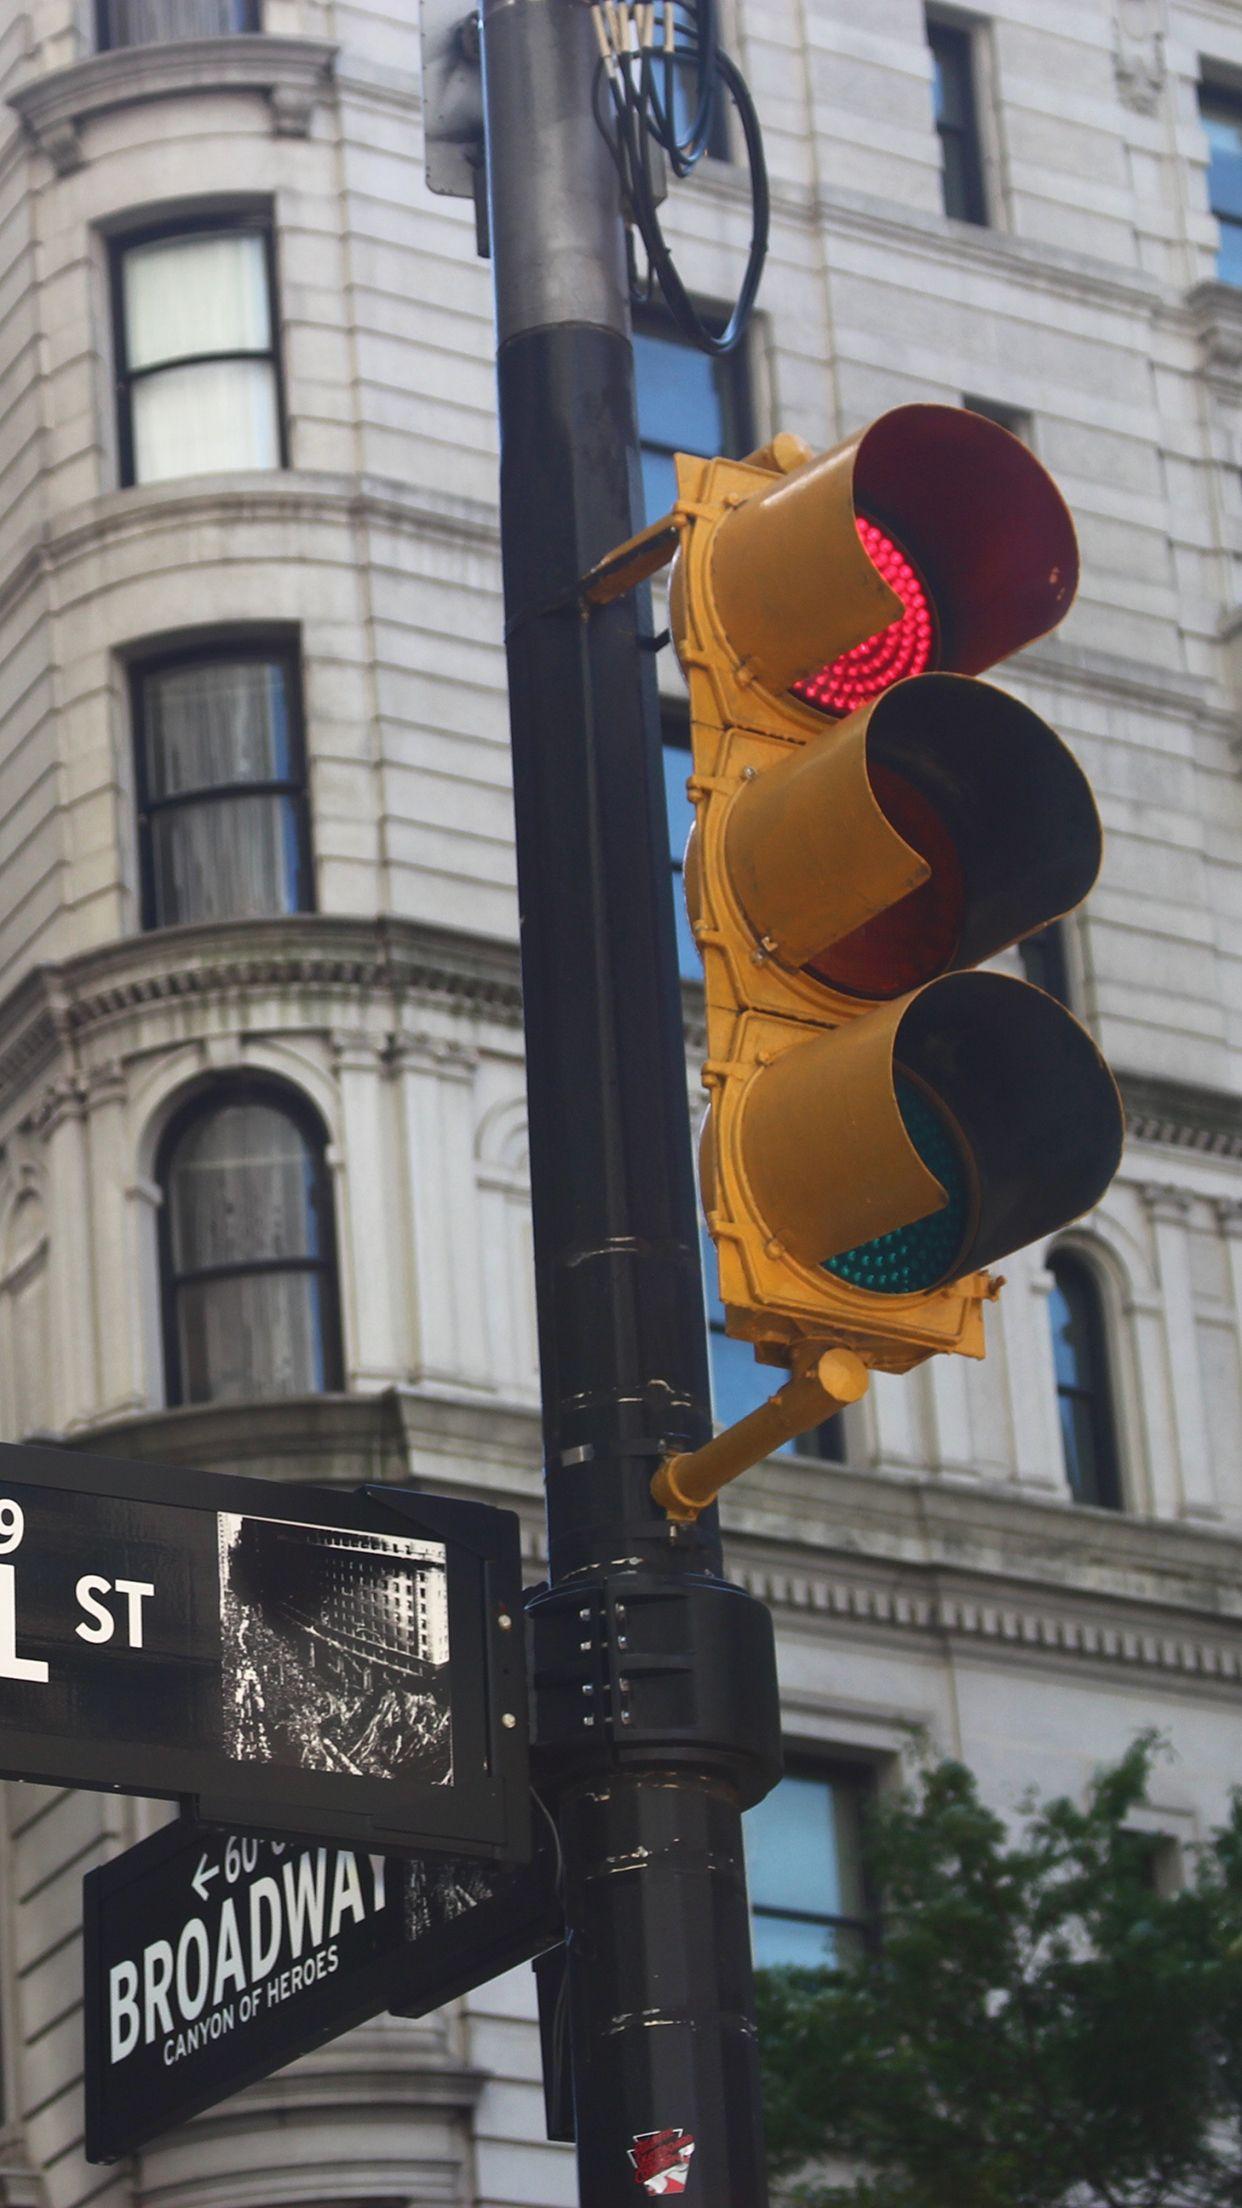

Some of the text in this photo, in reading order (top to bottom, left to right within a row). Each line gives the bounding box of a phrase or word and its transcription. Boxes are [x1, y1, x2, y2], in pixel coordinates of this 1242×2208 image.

[75, 1574, 155, 1648] ST
[110, 1847, 386, 2064] BROADWAY
[163, 1945, 339, 2066] CANYON OF HEROES
